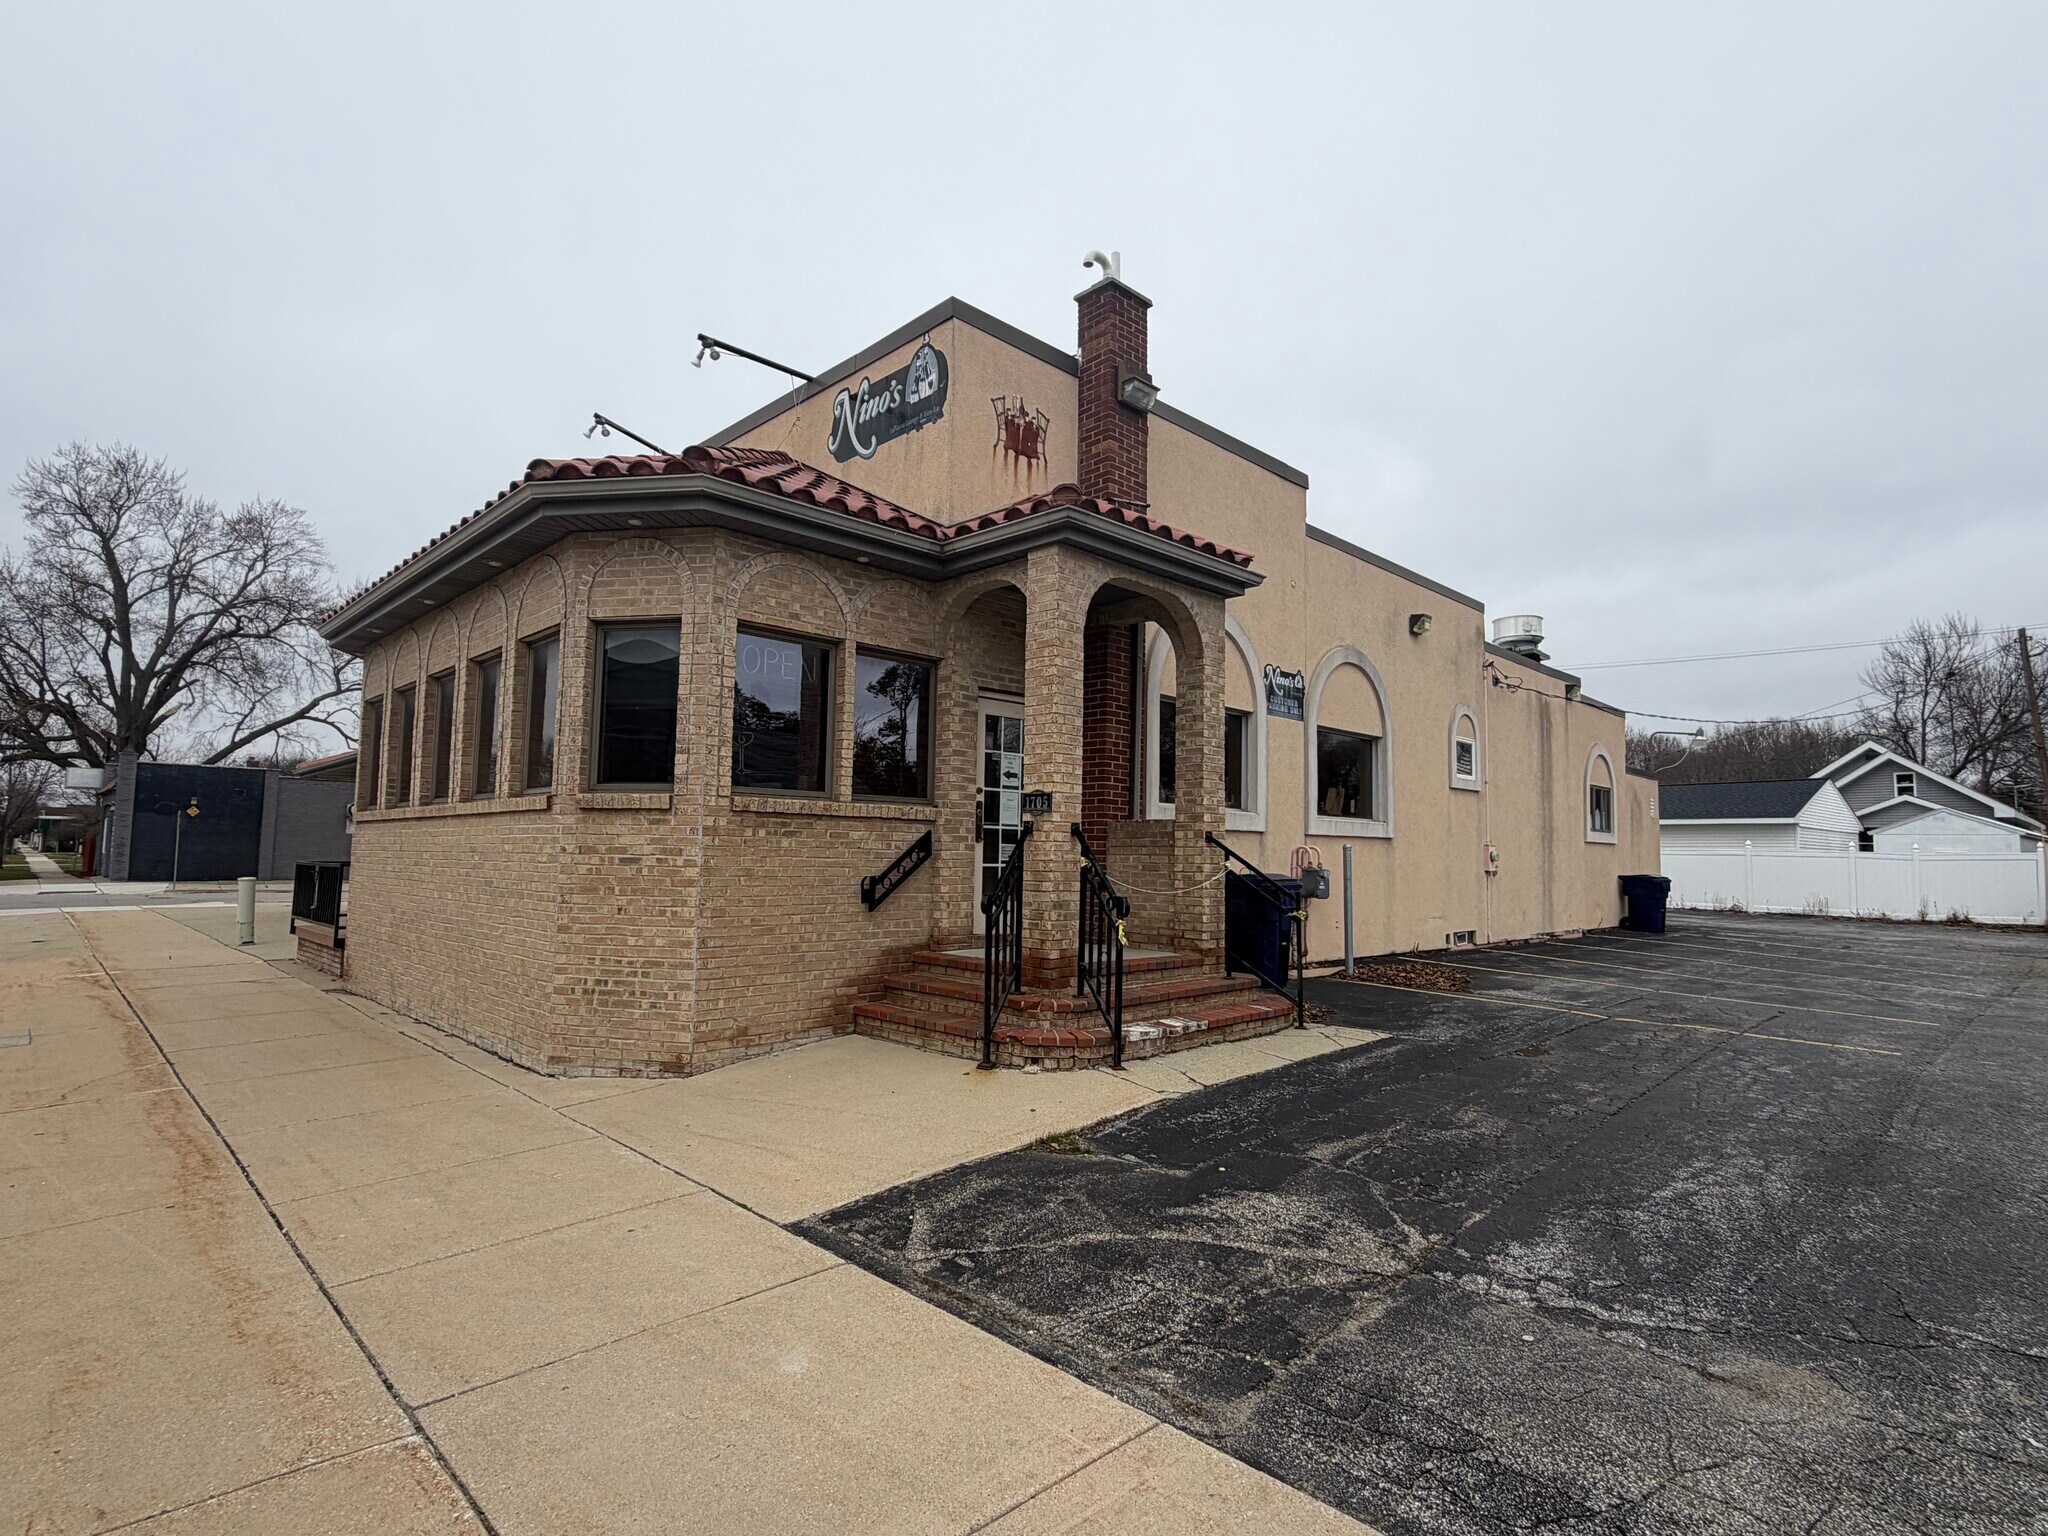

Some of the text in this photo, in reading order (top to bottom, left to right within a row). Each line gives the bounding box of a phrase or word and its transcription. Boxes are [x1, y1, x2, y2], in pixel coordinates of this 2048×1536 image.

[828, 378, 903, 455] Nino's
[743, 645, 817, 683] OPEN
[1263, 665, 1294, 695] Nino's
[1270, 695, 1299, 707] CUSTOMER
[1290, 706, 1302, 715] ONLY
[1025, 796, 1049, 809] 1705
